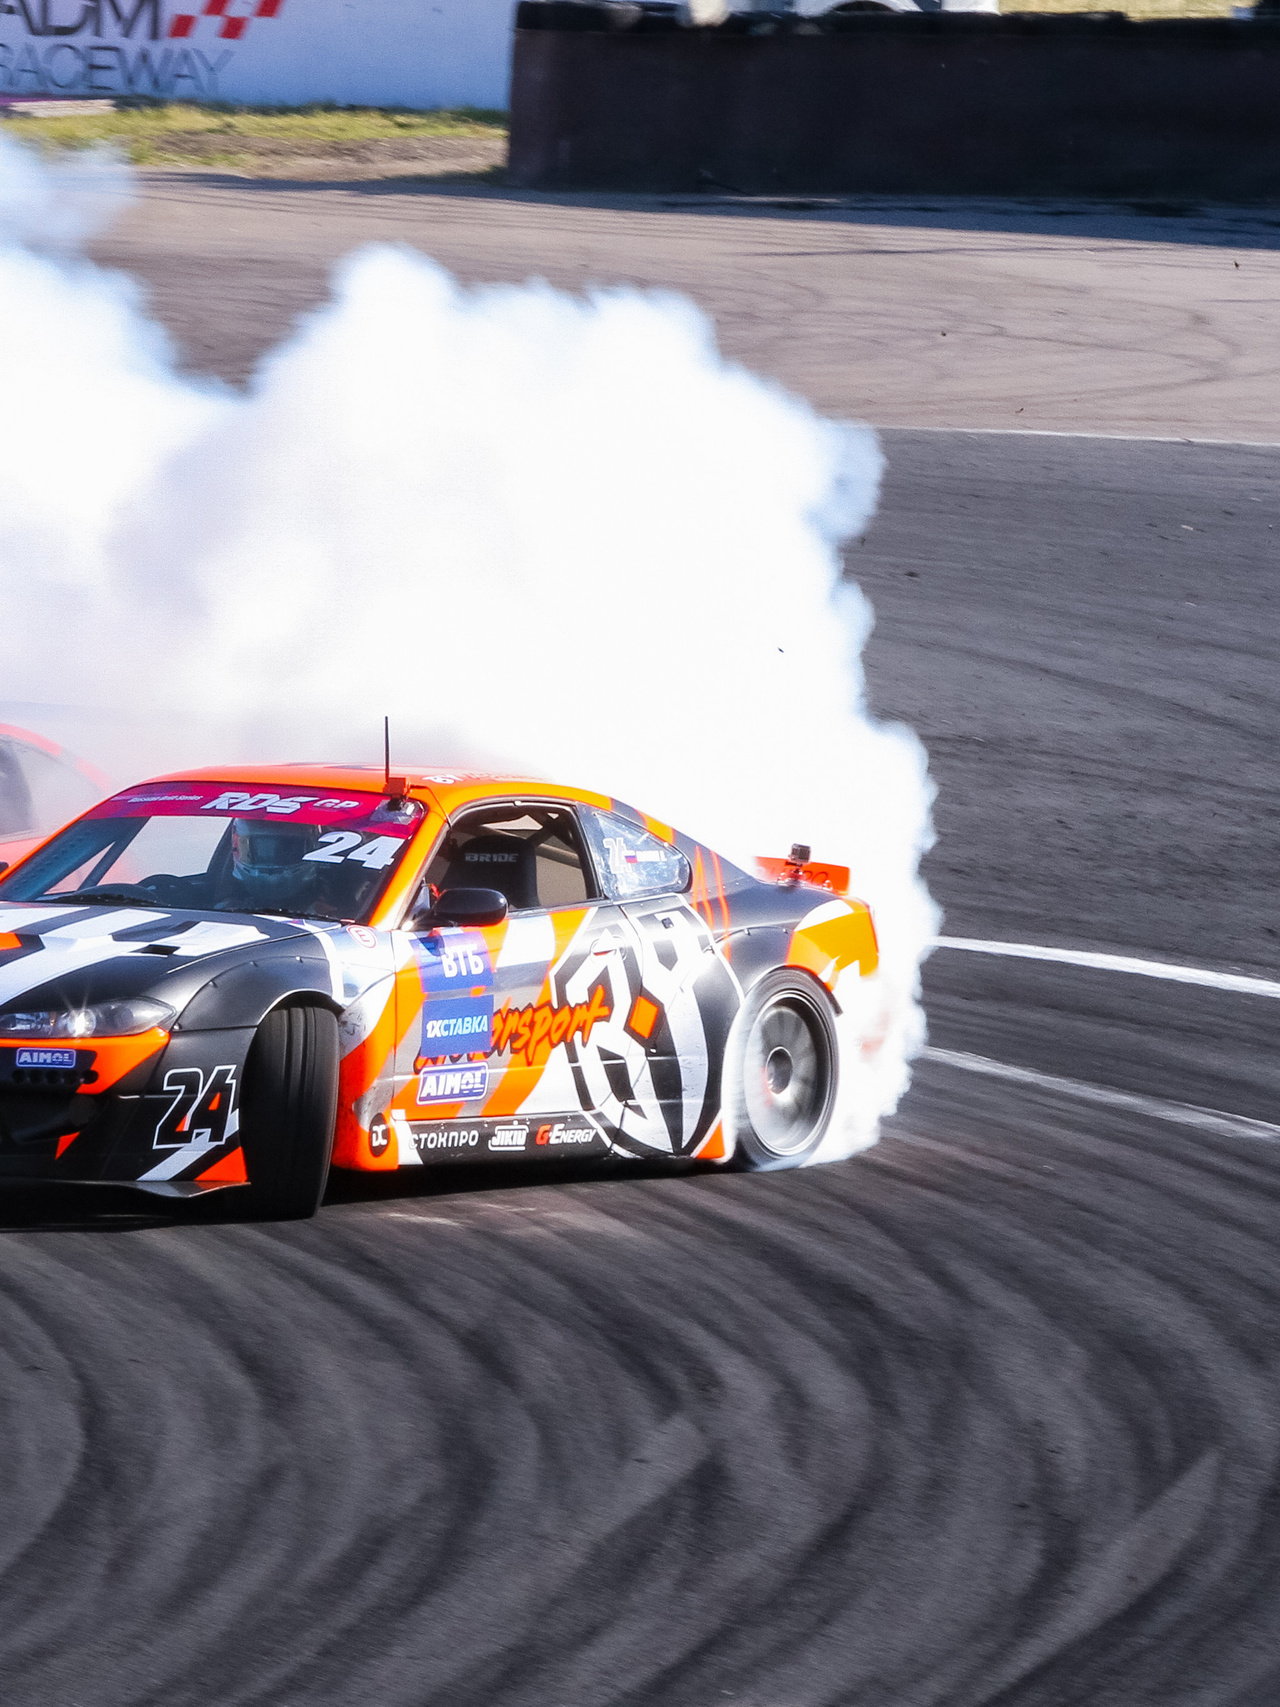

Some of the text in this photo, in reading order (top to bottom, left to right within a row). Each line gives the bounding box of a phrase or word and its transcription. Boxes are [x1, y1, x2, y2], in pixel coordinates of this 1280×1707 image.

[200, 791, 320, 814] RDS
[313, 799, 360, 809] GP
[302, 831, 406, 870] 24
[465, 852, 518, 863] BRIDE
[439, 942, 485, 978] ВТБ
[18, 1051, 73, 1065] AIMOL
[420, 1068, 487, 1098] AIMOL
[152, 1064, 238, 1150] 24
